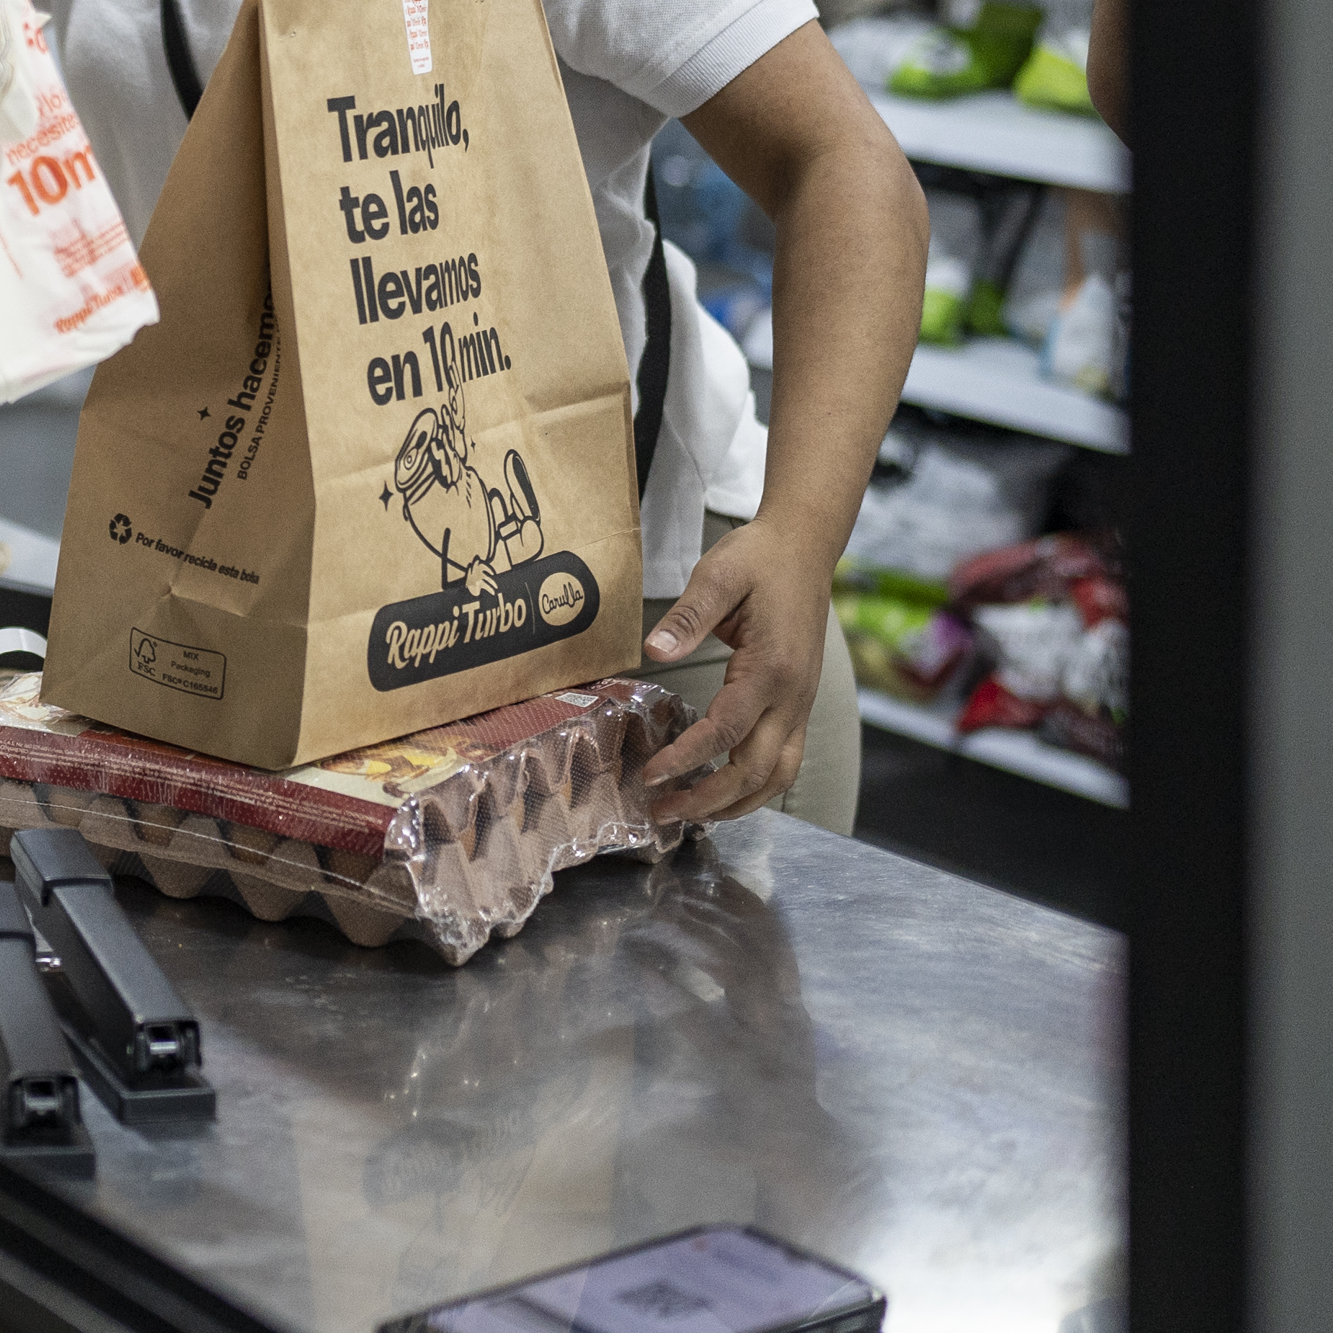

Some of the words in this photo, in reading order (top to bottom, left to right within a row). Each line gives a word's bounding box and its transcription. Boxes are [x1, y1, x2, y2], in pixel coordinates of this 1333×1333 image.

[327, 83, 469, 169] Tranquilo,
[339, 186, 390, 244] te
[389, 170, 439, 235] las
[349, 252, 482, 325] llevamos
[188, 416, 246, 510] Juntos
[227, 288, 275, 412] hacemo
[367, 351, 423, 406] en
[237, 435, 263, 480] BOLSA
[135, 532, 154, 548] Por
[155, 538, 184, 559] favor
[183, 552, 217, 572] recicla
[218, 564, 240, 580] esta
[386, 605, 460, 669] Rappi
[462, 592, 527, 644] Turbo
[541, 581, 584, 615] Carulla
[137, 661, 156, 677] FSC
[170, 660, 211, 679] Packaging
[183, 650, 200, 662] MIX
